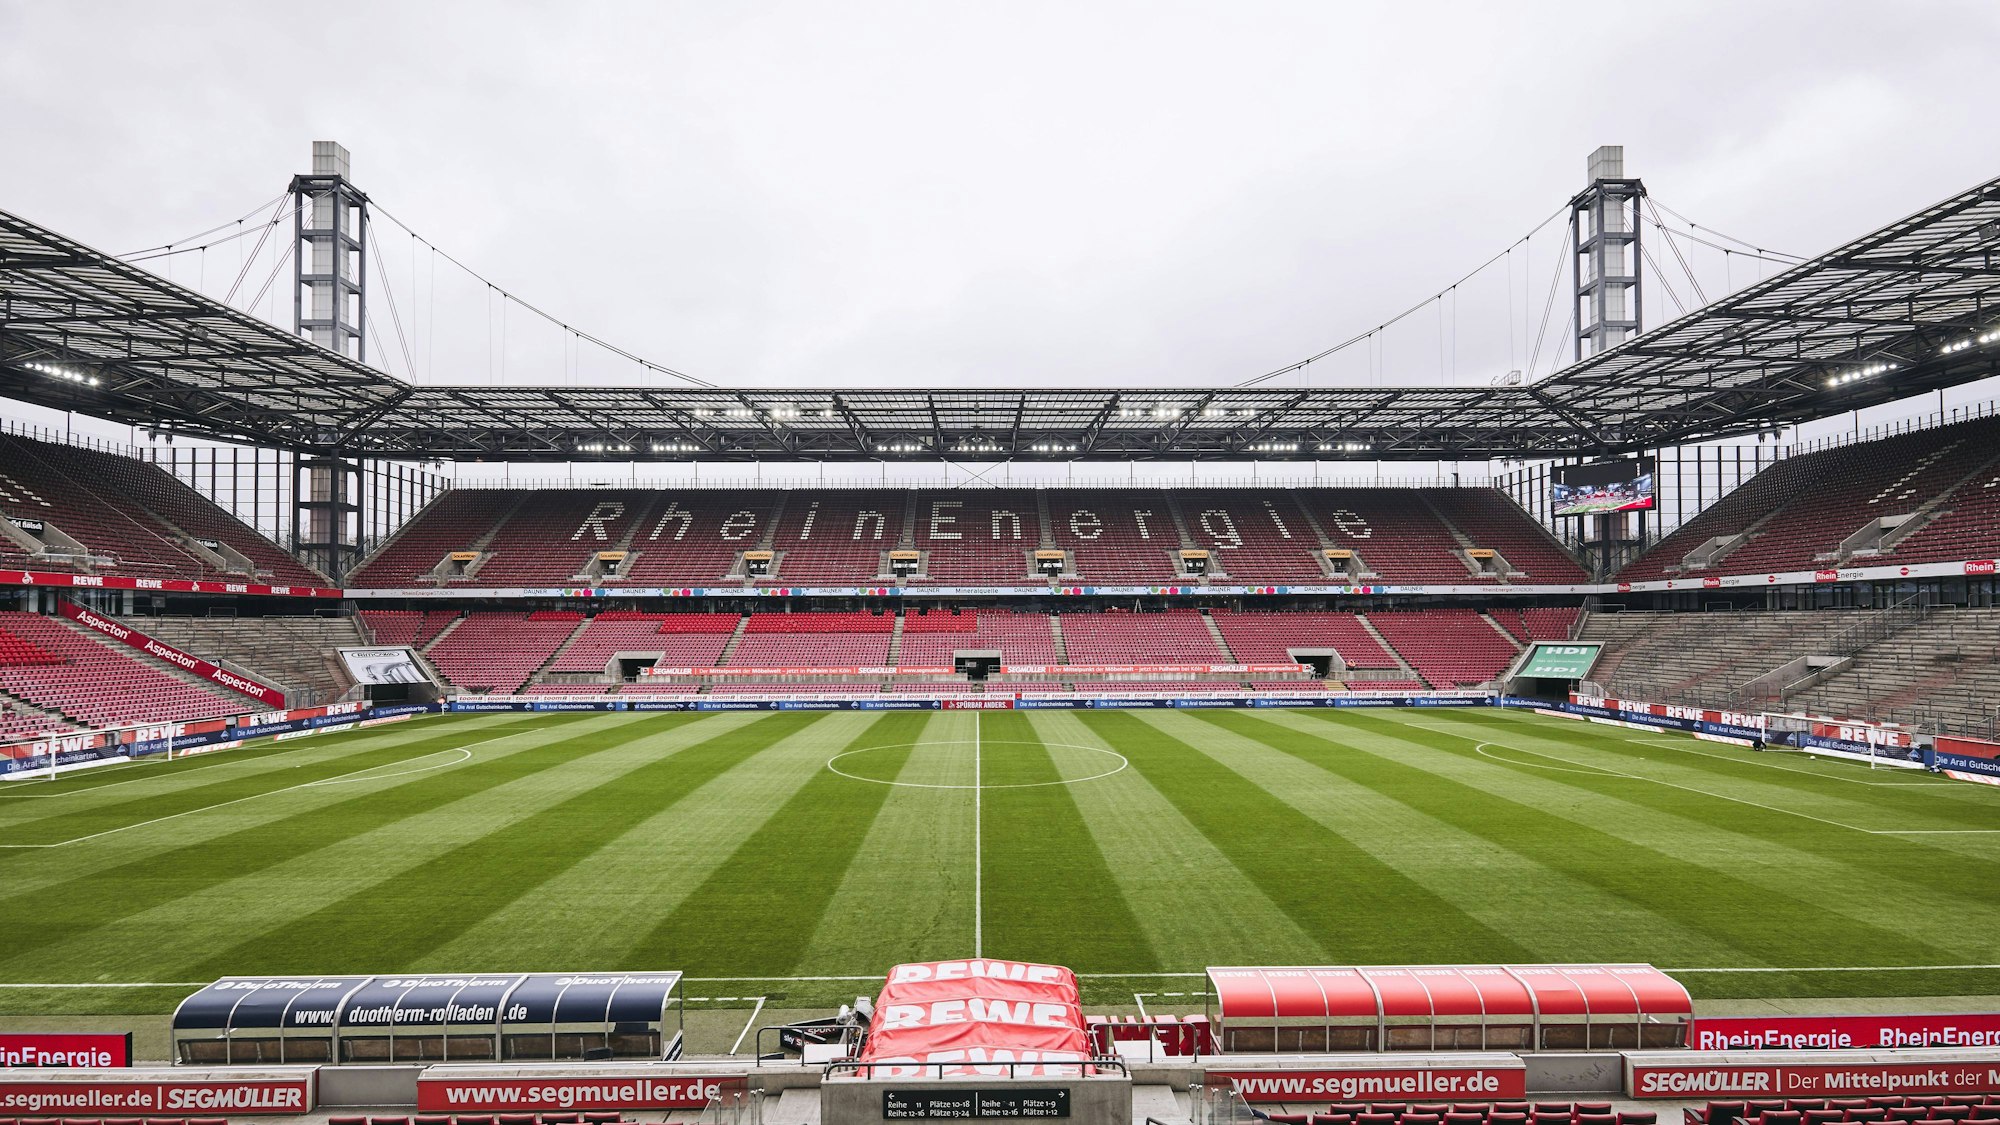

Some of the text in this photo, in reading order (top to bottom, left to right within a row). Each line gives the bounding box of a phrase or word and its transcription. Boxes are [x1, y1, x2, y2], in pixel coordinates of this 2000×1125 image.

[571, 501, 1372, 550] RheinEnergie
[73, 576, 103, 586] REWE
[1816, 571, 1864, 580] RheinEnergie
[136, 578, 162, 589] REWE
[226, 584, 247, 593] REWE
[271, 586, 290, 595] REWE
[77, 610, 129, 640] Aspecton
[145, 640, 196, 669] Aspecton
[212, 669, 264, 698] Aspecton
[956, 700, 980, 708] SPÜRBAR
[1577, 695, 1606, 708] REWE
[1618, 700, 1651, 714] REWE
[327, 702, 358, 716] REWE
[1666, 706, 1704, 721] REWE
[1648, 716, 1682, 727] Gutscheinkarten.
[136, 724, 185, 742] REWE
[1729, 727, 1772, 739] Gutscheinkaen.
[1840, 727, 1898, 747] REWE
[33, 735, 95, 756] REWE
[163, 736, 208, 747] Gscheinkarten.
[1832, 742, 1888, 756] Gutscheinkaten.
[23, 760, 37, 769] Aral
[1936, 756, 1948, 764] Die
[1950, 758, 1966, 767] Aral
[883, 998, 1067, 1030] REWE
[784, 1034, 794, 1044] sky
[1700, 1029, 1852, 1050] RheinEnergie
[874, 1047, 1080, 1077] REWE
[1232, 1071, 1498, 1098] www.segmueller.de
[1641, 1070, 1769, 1092] SEGMÜLLER
[1788, 1072, 1818, 1089] Der
[1825, 1070, 1948, 1092] Mittelpunkt
[1954, 1069, 1982, 1086] der
[166, 1086, 302, 1110] SEGMÜLLER
[446, 1079, 720, 1108] www.segmueller.de
